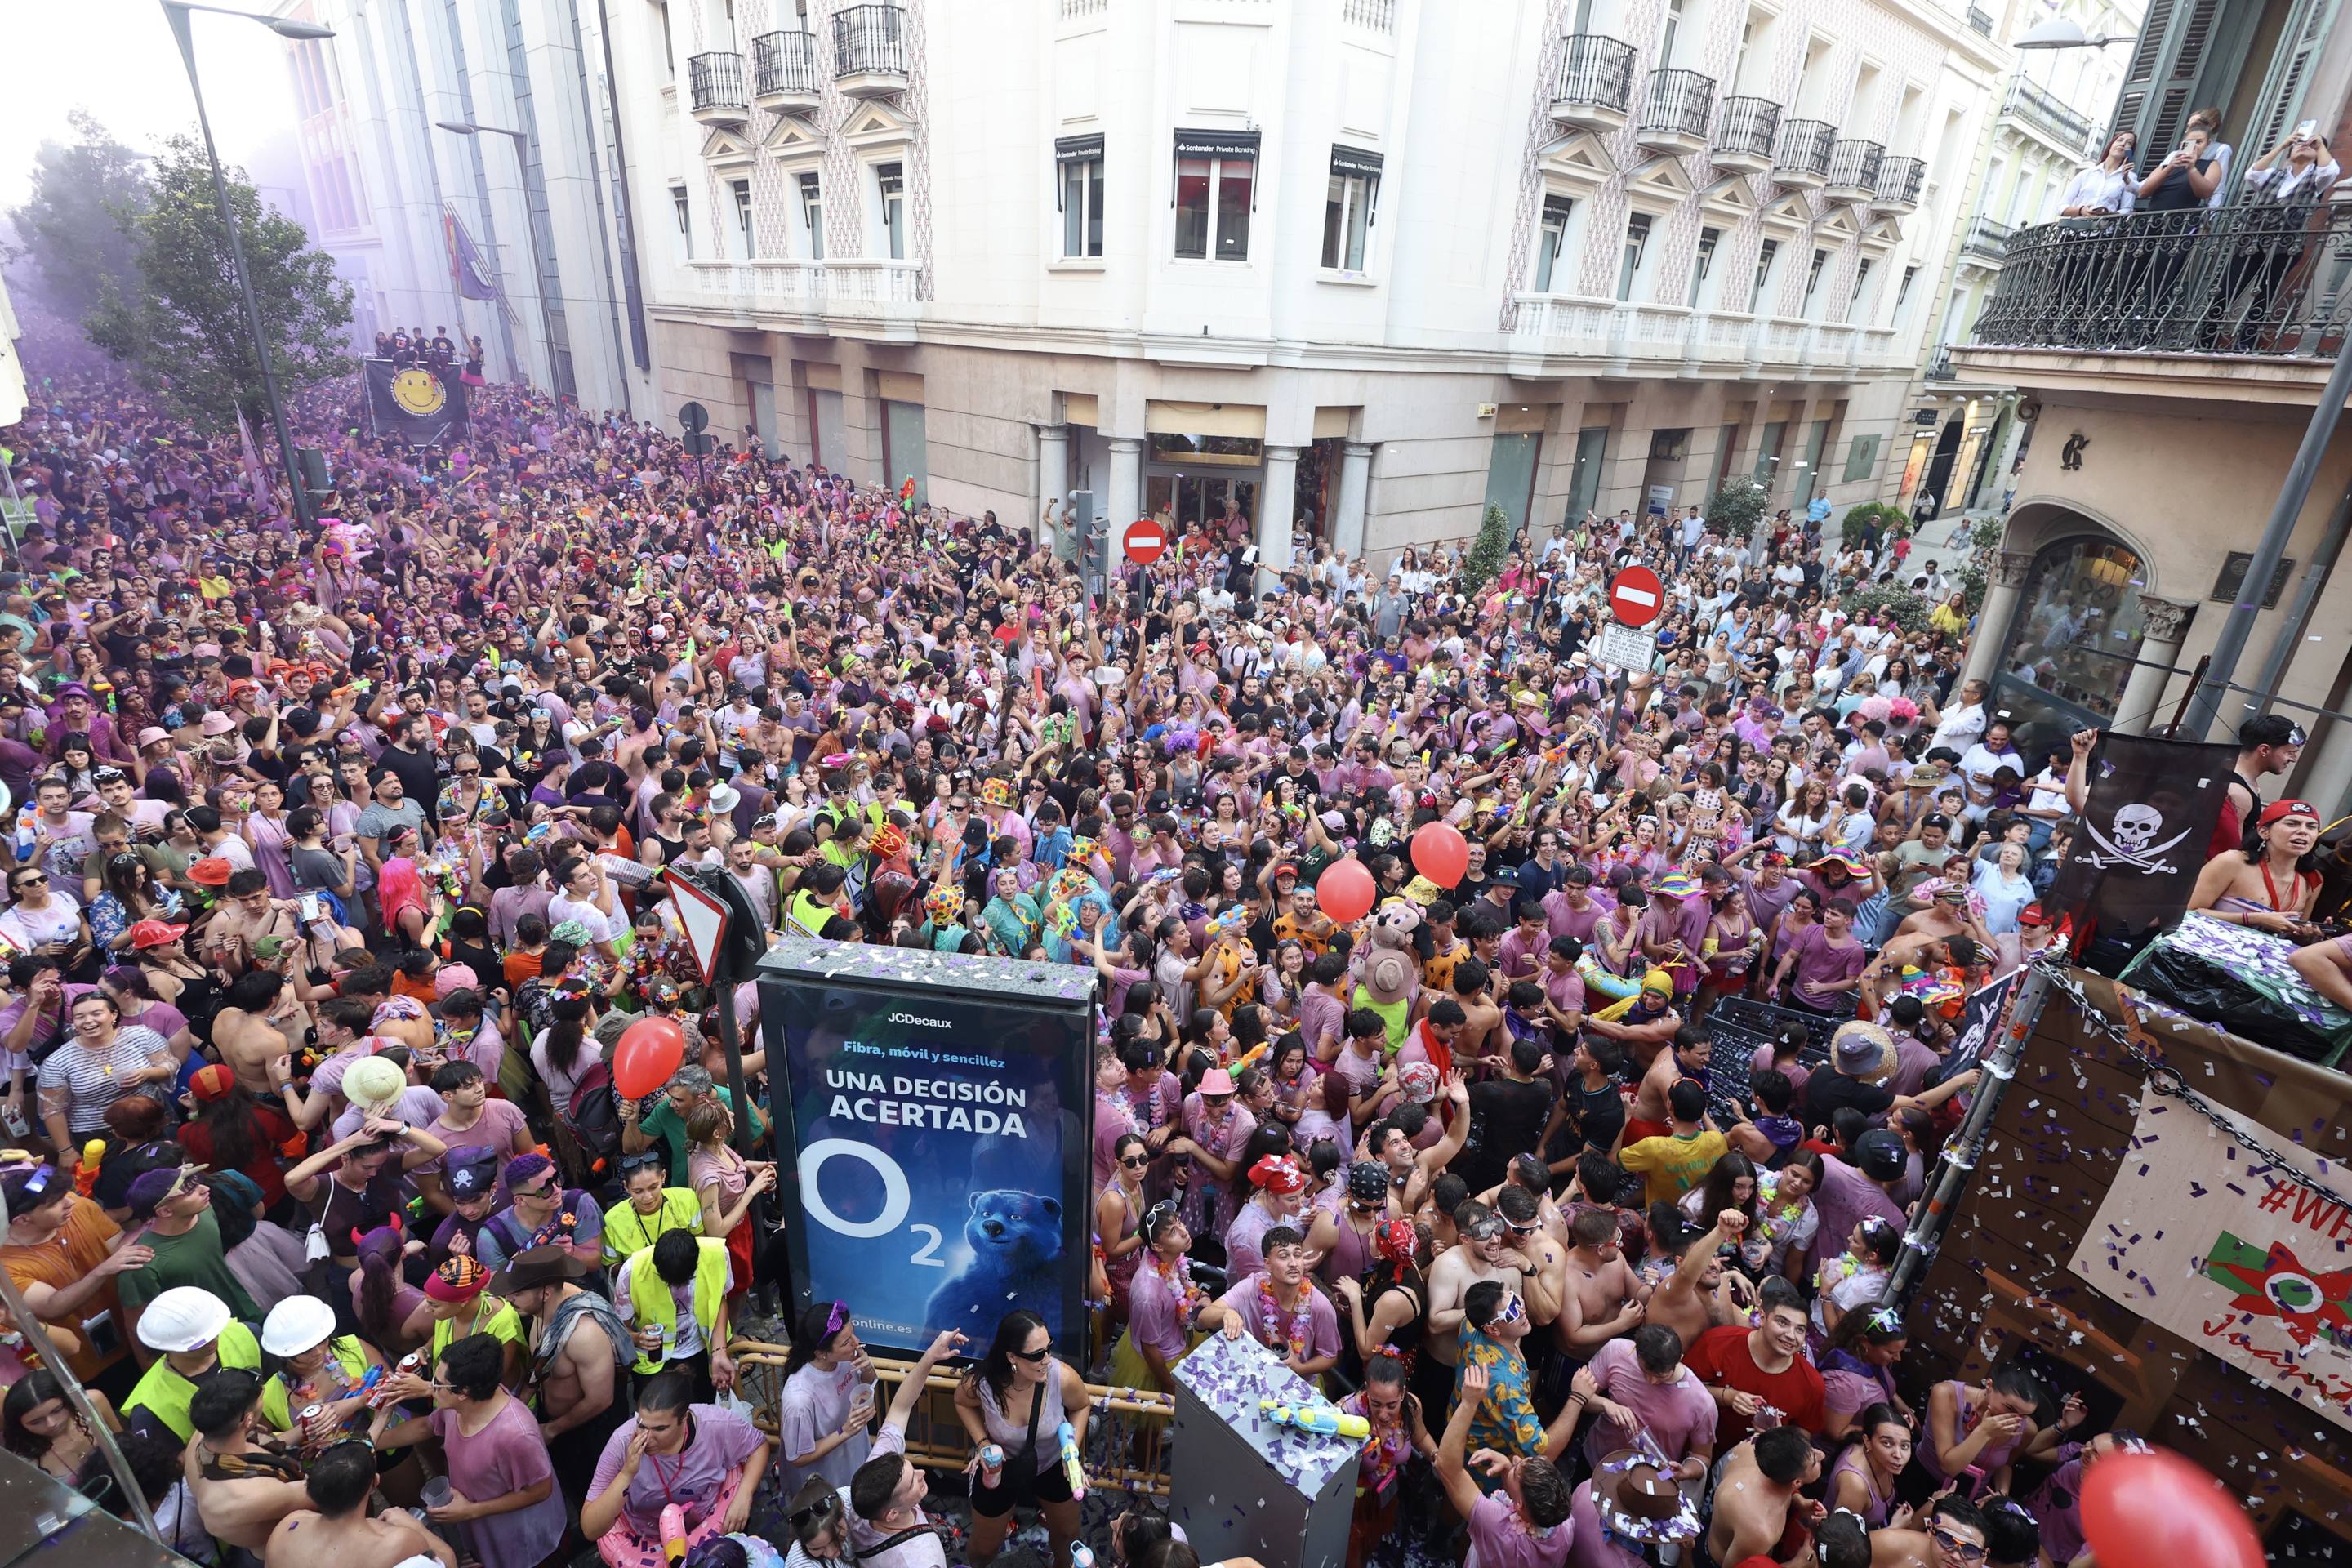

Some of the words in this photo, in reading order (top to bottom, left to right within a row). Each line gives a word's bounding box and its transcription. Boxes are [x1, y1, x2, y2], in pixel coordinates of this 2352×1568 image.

[1234, 146, 1255, 154] Banking
[1339, 160, 1356, 169] Santander
[1370, 166, 1382, 174] Banking
[1615, 628, 1643, 640] EXCEPTO
[888, 1012, 952, 1029] JCDecaux
[844, 1040, 885, 1058] Fibra,
[889, 1046, 929, 1061] móvil
[930, 1052, 940, 1063] y
[942, 1052, 1006, 1069] sencillez
[826, 1069, 887, 1094] UNA
[893, 1076, 1027, 1107] DECISIÓN
[829, 1094, 1027, 1138] ACERTADA
[851, 1319, 913, 1334] online.es
